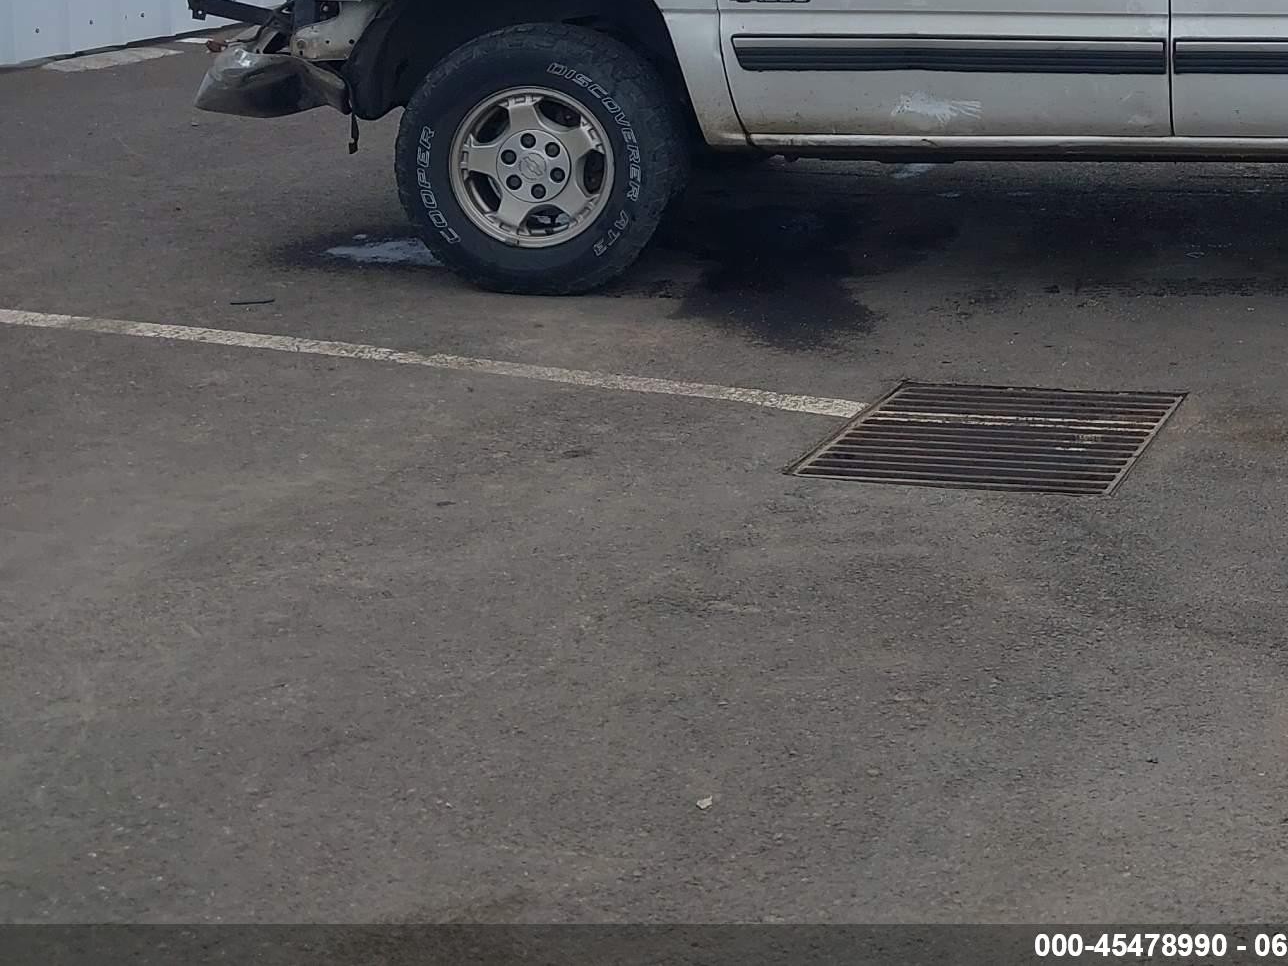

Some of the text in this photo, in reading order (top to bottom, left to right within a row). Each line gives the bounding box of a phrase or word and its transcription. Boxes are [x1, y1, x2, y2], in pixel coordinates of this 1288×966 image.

[415, 126, 462, 244] COOPER
[546, 63, 642, 257] DISCOVERER AT3
